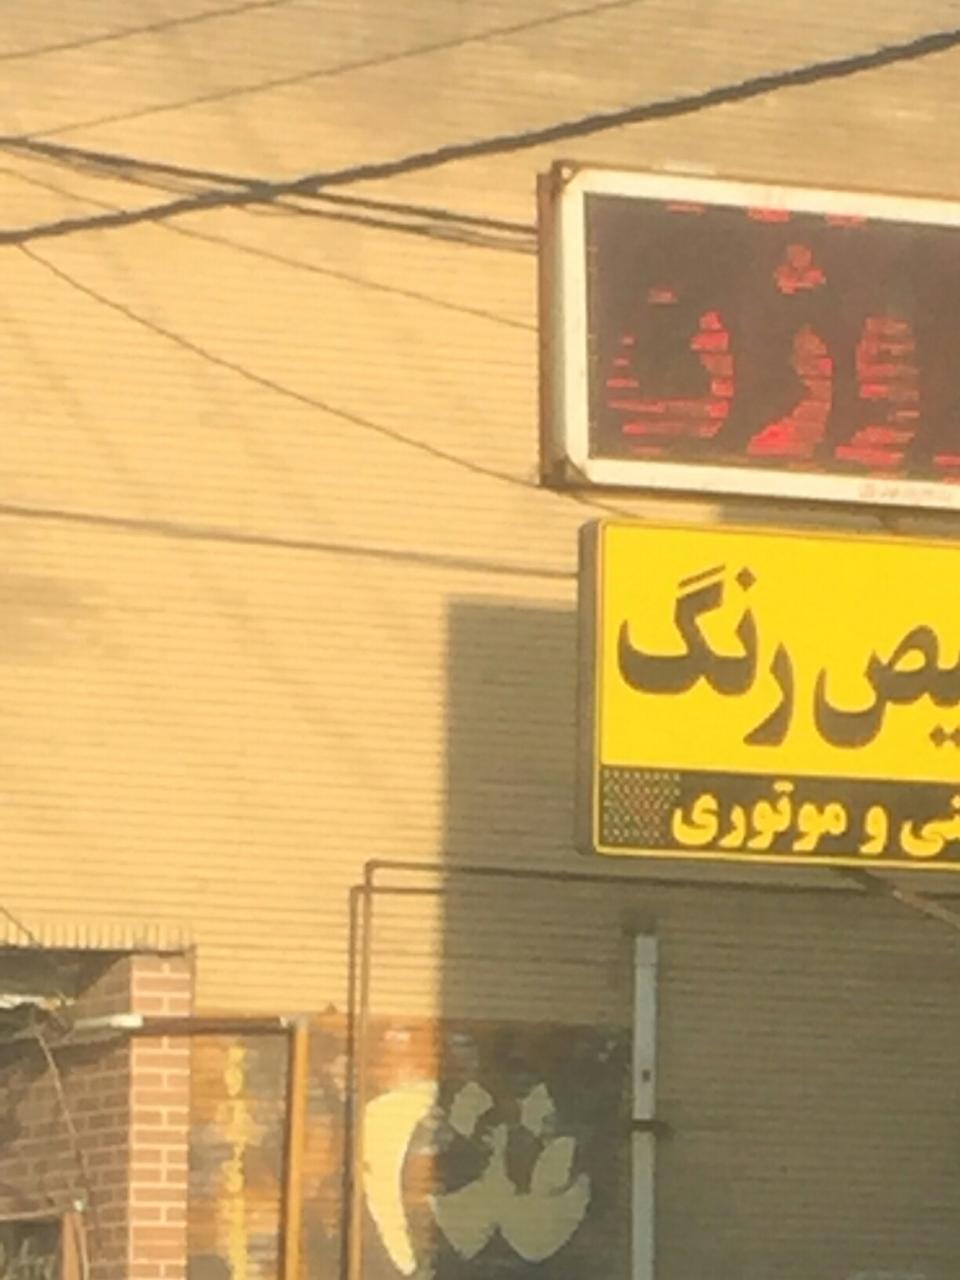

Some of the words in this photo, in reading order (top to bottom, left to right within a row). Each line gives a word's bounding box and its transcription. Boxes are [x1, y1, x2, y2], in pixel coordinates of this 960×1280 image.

[616, 564, 795, 747] رنگ
[671, 781, 849, 853] موتوری
[858, 804, 889, 855] و
